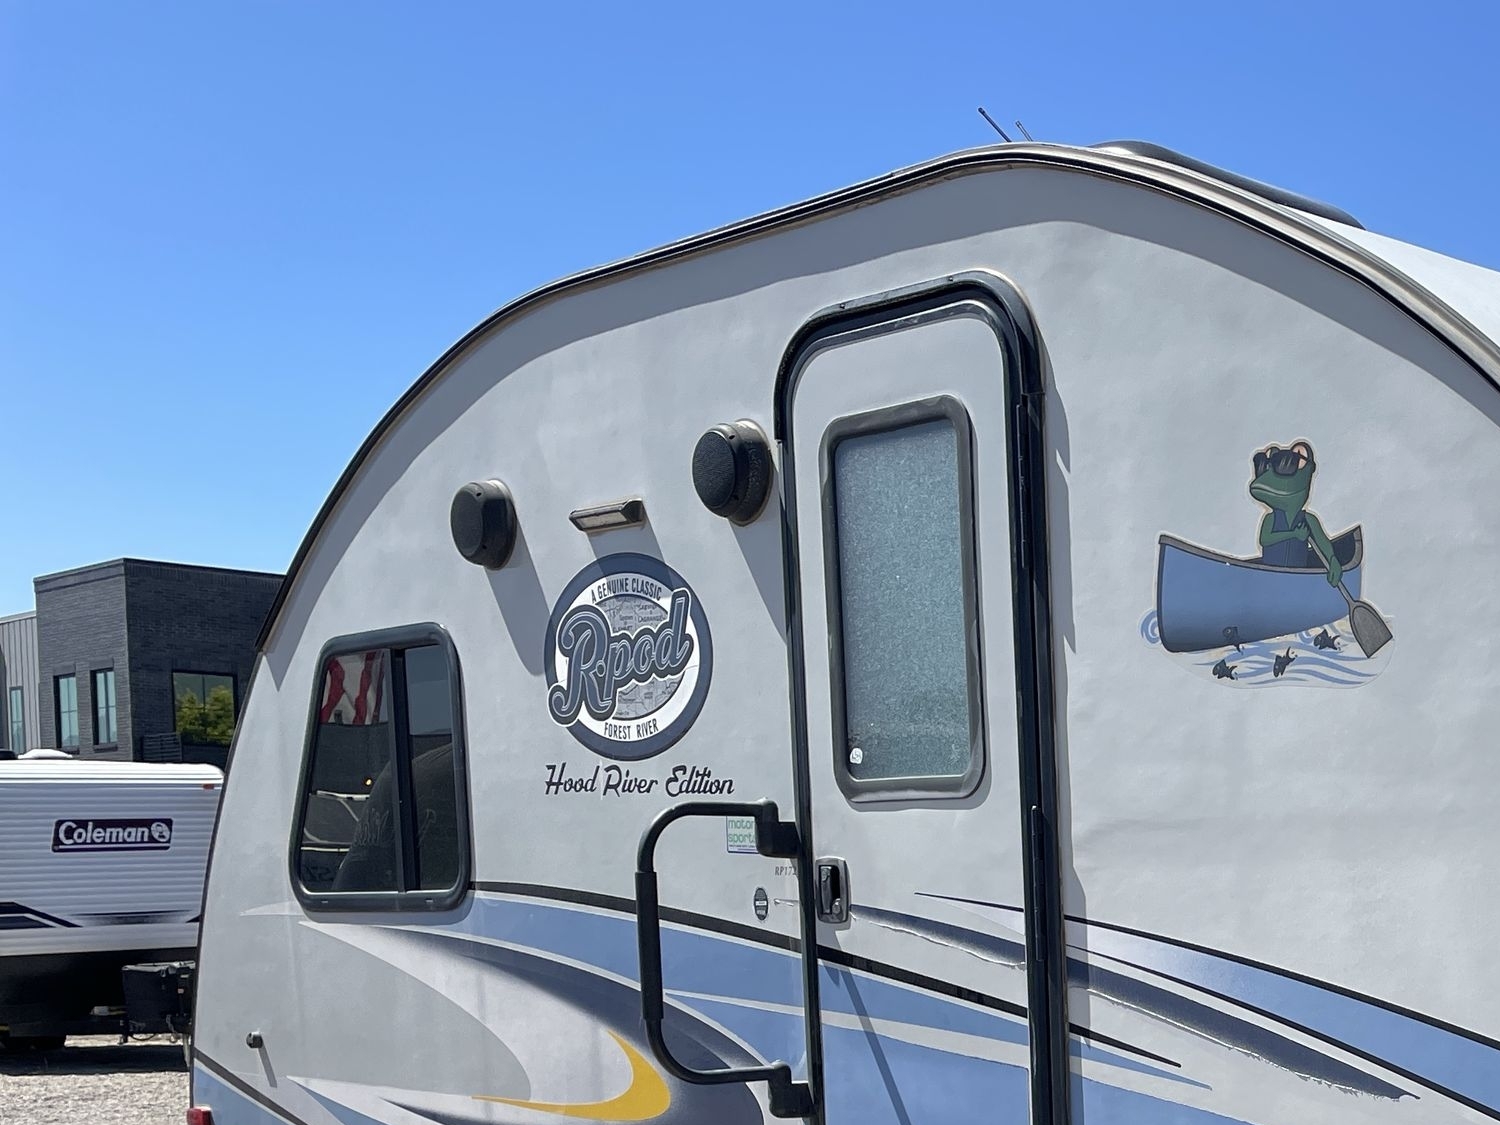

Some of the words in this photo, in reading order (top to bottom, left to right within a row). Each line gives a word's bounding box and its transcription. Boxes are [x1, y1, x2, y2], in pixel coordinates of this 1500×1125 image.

[597, 578, 629, 599] GENUINE
[631, 577, 662, 601] CLASSIC
[604, 721, 631, 739] FOREST
[636, 718, 659, 738] RIVER
[545, 762, 600, 795] Hood
[602, 764, 658, 797] River
[666, 765, 734, 797] Edition
[59, 821, 149, 844] Coleman
[728, 833, 755, 844] sport
